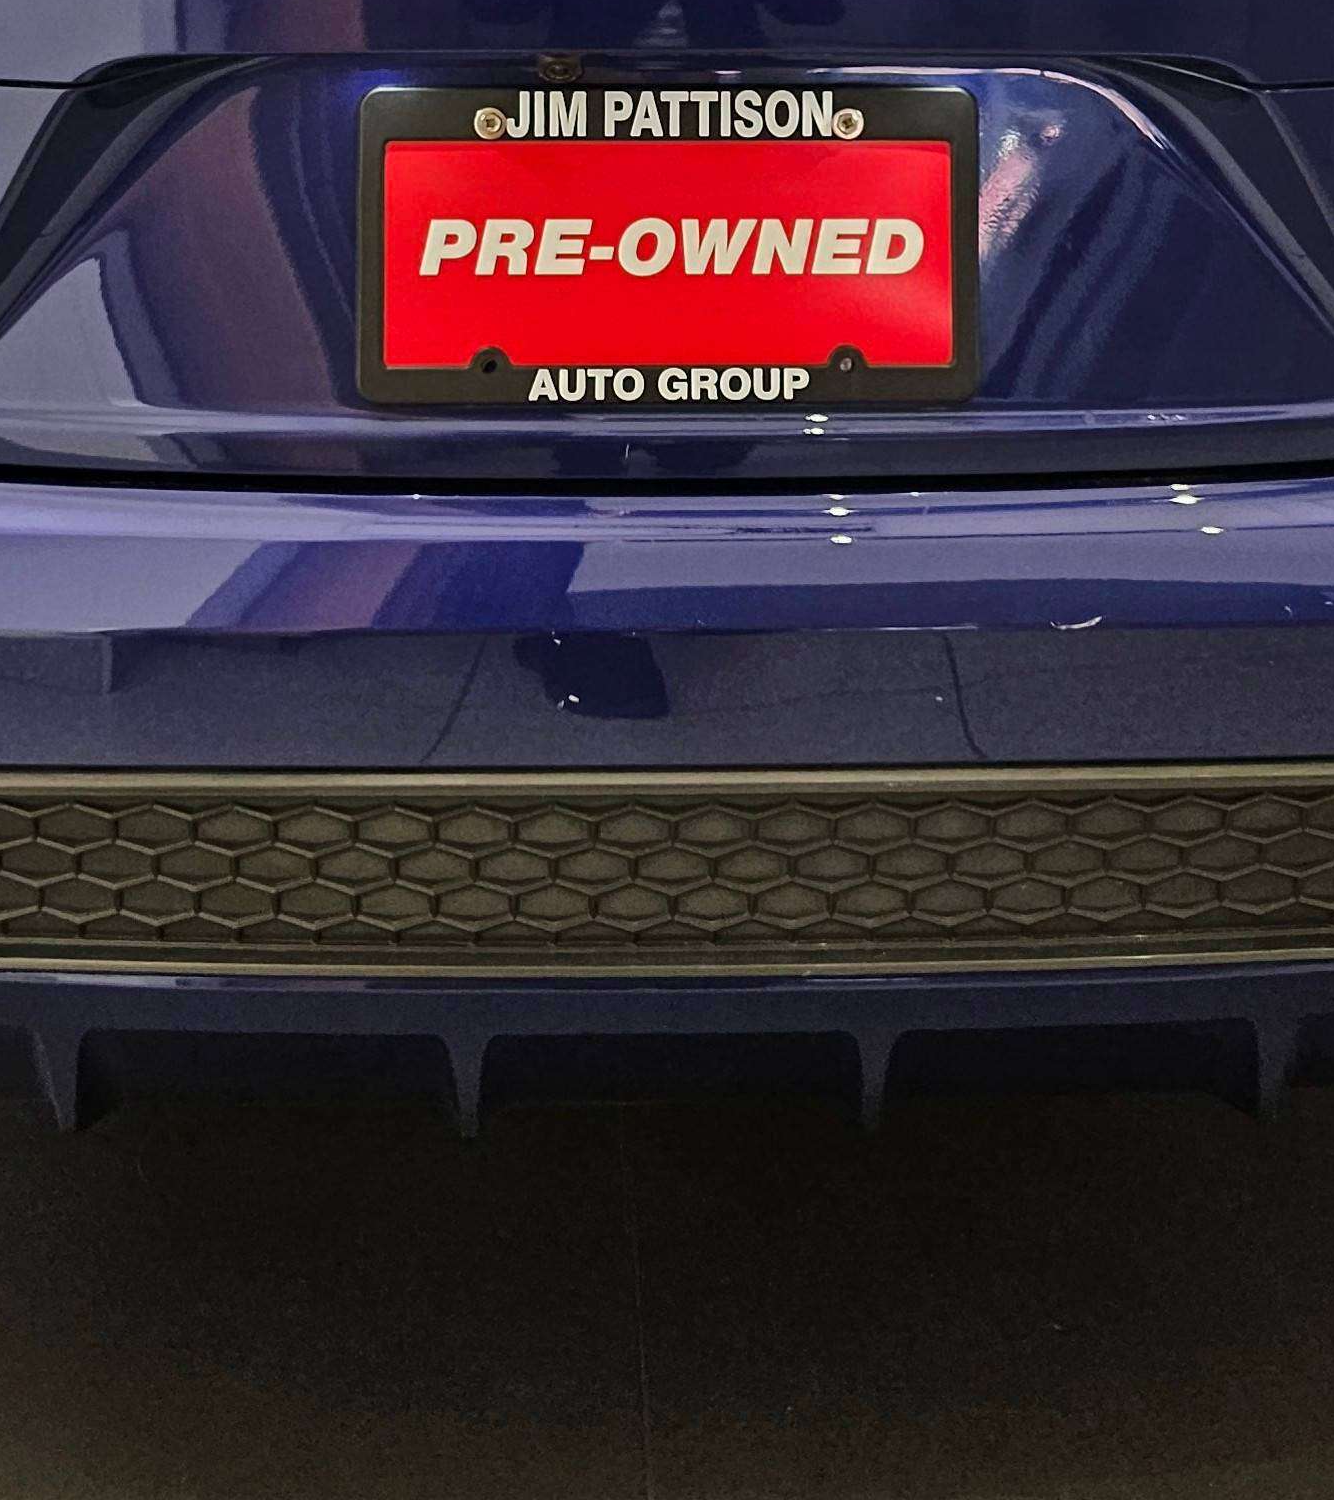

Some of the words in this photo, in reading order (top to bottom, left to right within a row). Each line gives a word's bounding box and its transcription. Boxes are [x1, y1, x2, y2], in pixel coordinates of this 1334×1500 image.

[506, 90, 587, 137] JIM
[604, 90, 833, 138] PATTISON
[419, 218, 924, 276] PRE-OWNED
[528, 368, 645, 401] AUTO
[657, 367, 810, 401] GROUP
